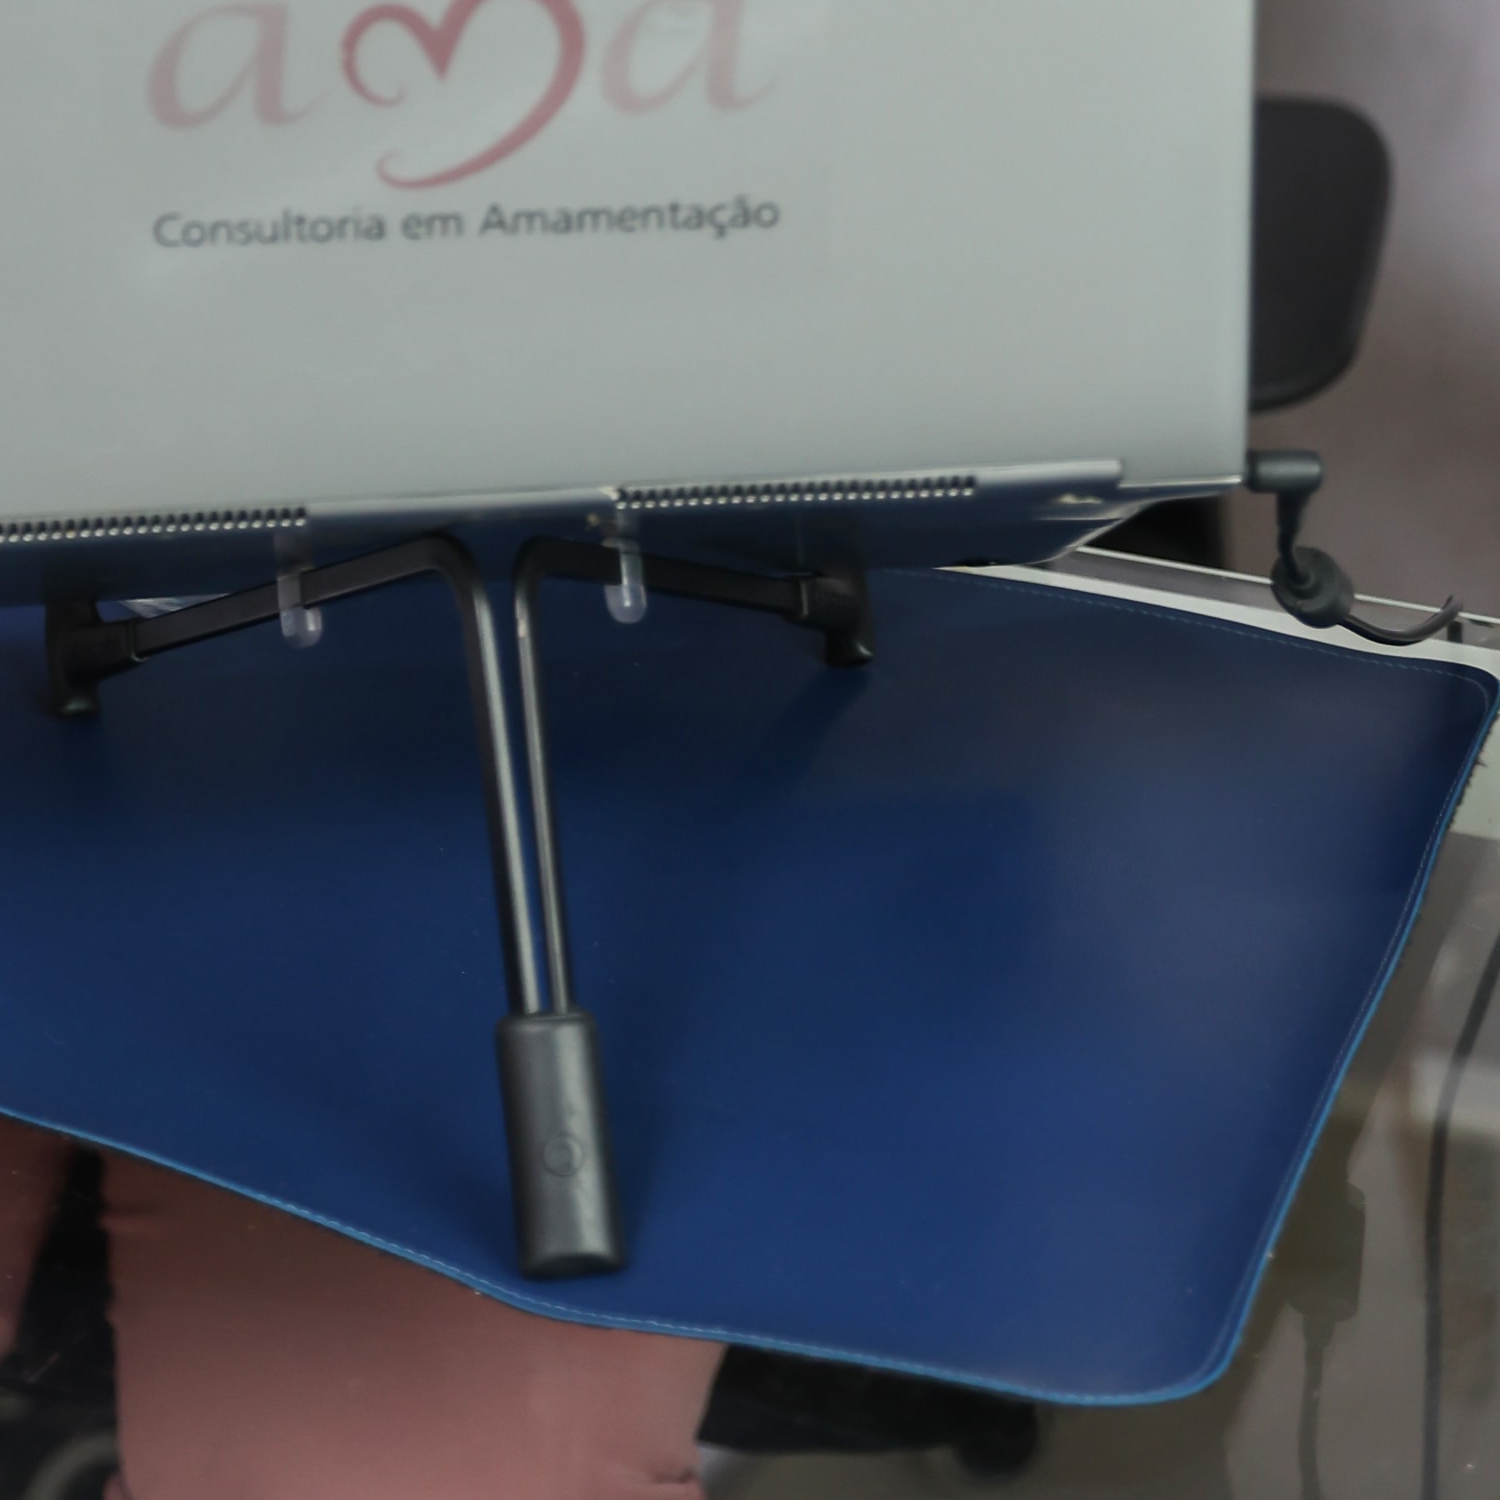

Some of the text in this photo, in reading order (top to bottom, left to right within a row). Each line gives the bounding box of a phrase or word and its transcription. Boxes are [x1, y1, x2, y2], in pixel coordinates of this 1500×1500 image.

[152, 193, 782, 248] Consultoria em Amamentação
